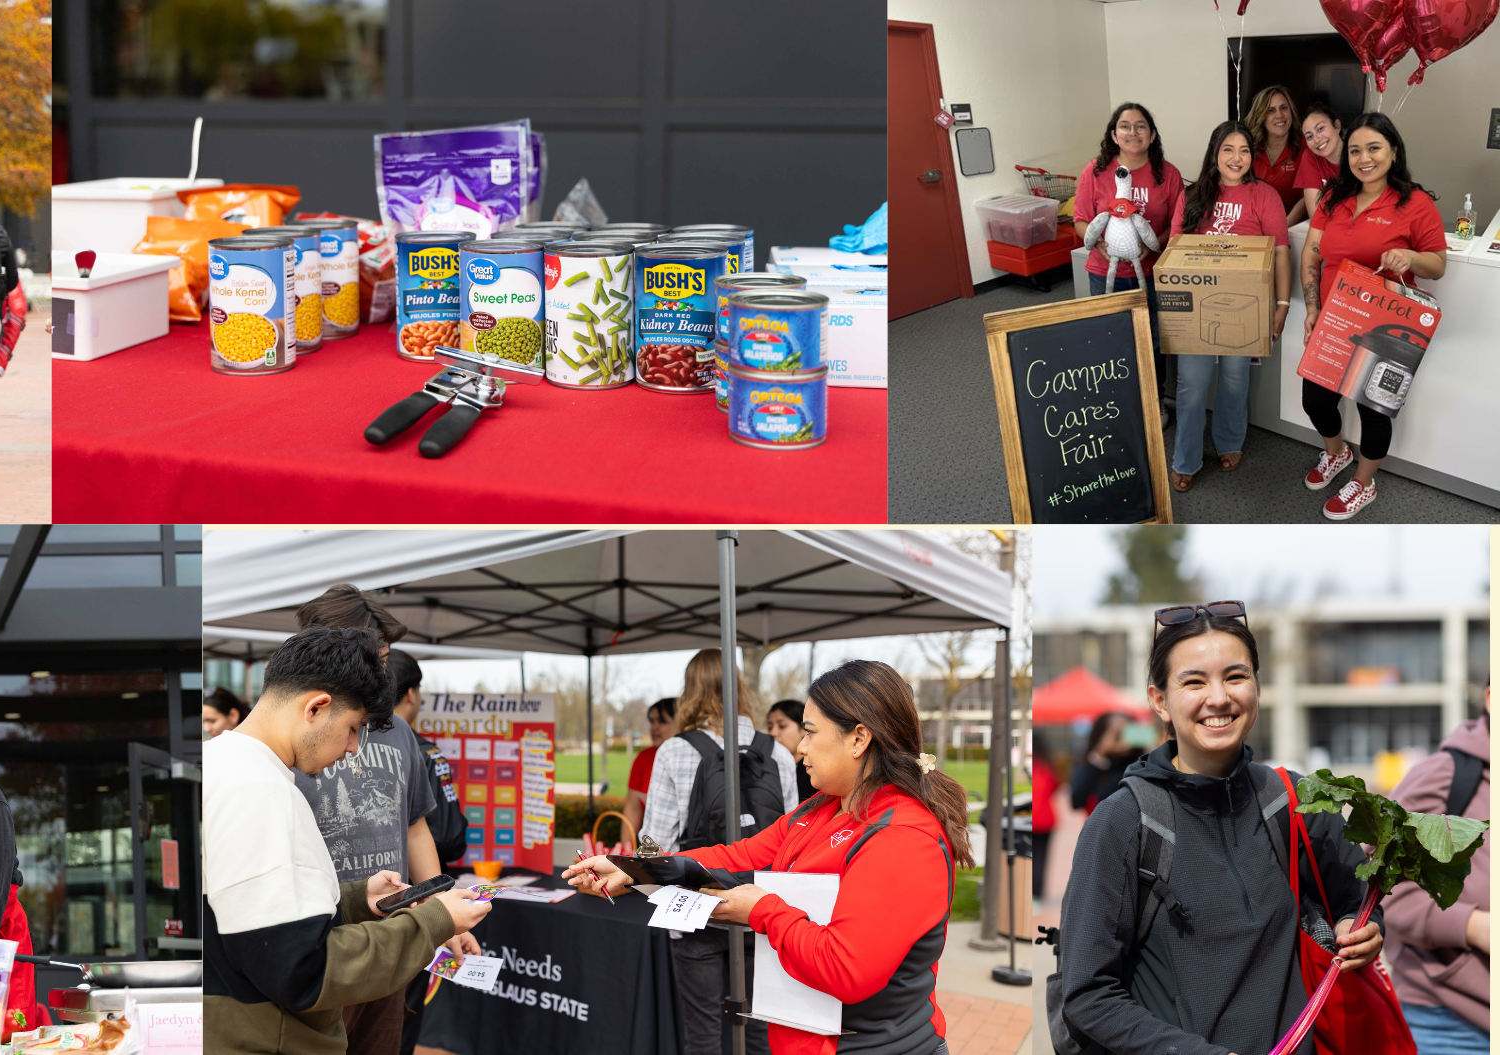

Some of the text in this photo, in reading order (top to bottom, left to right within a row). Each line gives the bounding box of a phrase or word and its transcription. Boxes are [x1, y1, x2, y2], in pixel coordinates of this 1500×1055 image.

[1130, 187, 1149, 203] TAN
[1213, 201, 1242, 220] STAN
[411, 254, 460, 272] BUSH'S
[469, 263, 494, 275] Great
[250, 279, 267, 288] Sweet
[294, 273, 306, 281] ole
[474, 271, 495, 281] Value
[646, 271, 703, 292] BUSH'S
[1158, 274, 1218, 286] COSORI
[211, 285, 267, 297] Whole Kernel
[473, 292, 536, 304] Sweet Peas
[1337, 277, 1413, 319] Instant Pot
[244, 297, 267, 306] Corn
[405, 293, 460, 306] Pinto Bea
[553, 299, 570, 310] Added
[410, 312, 441, 320] FRIJOLES
[1331, 298, 1370, 318] MULTI-COOKER
[546, 319, 559, 337] EEN
[640, 318, 675, 335] Kidney
[677, 319, 714, 333] Beans
[739, 316, 790, 334] ORTEGA
[643, 336, 663, 344] FRIJOLES
[681, 337, 707, 346] OSCUROS
[752, 343, 773, 351] DICED
[1026, 357, 1130, 398] Campus
[750, 390, 804, 406] ORTEGA
[765, 416, 788, 424] DICED
[1044, 401, 1120, 438] Cares
[1059, 432, 1113, 466] Fair
[430, 693, 466, 713] The
[501, 945, 563, 982] Needs
[540, 991, 589, 1022] STATE
[148, 1013, 194, 1029] Jaedyn
